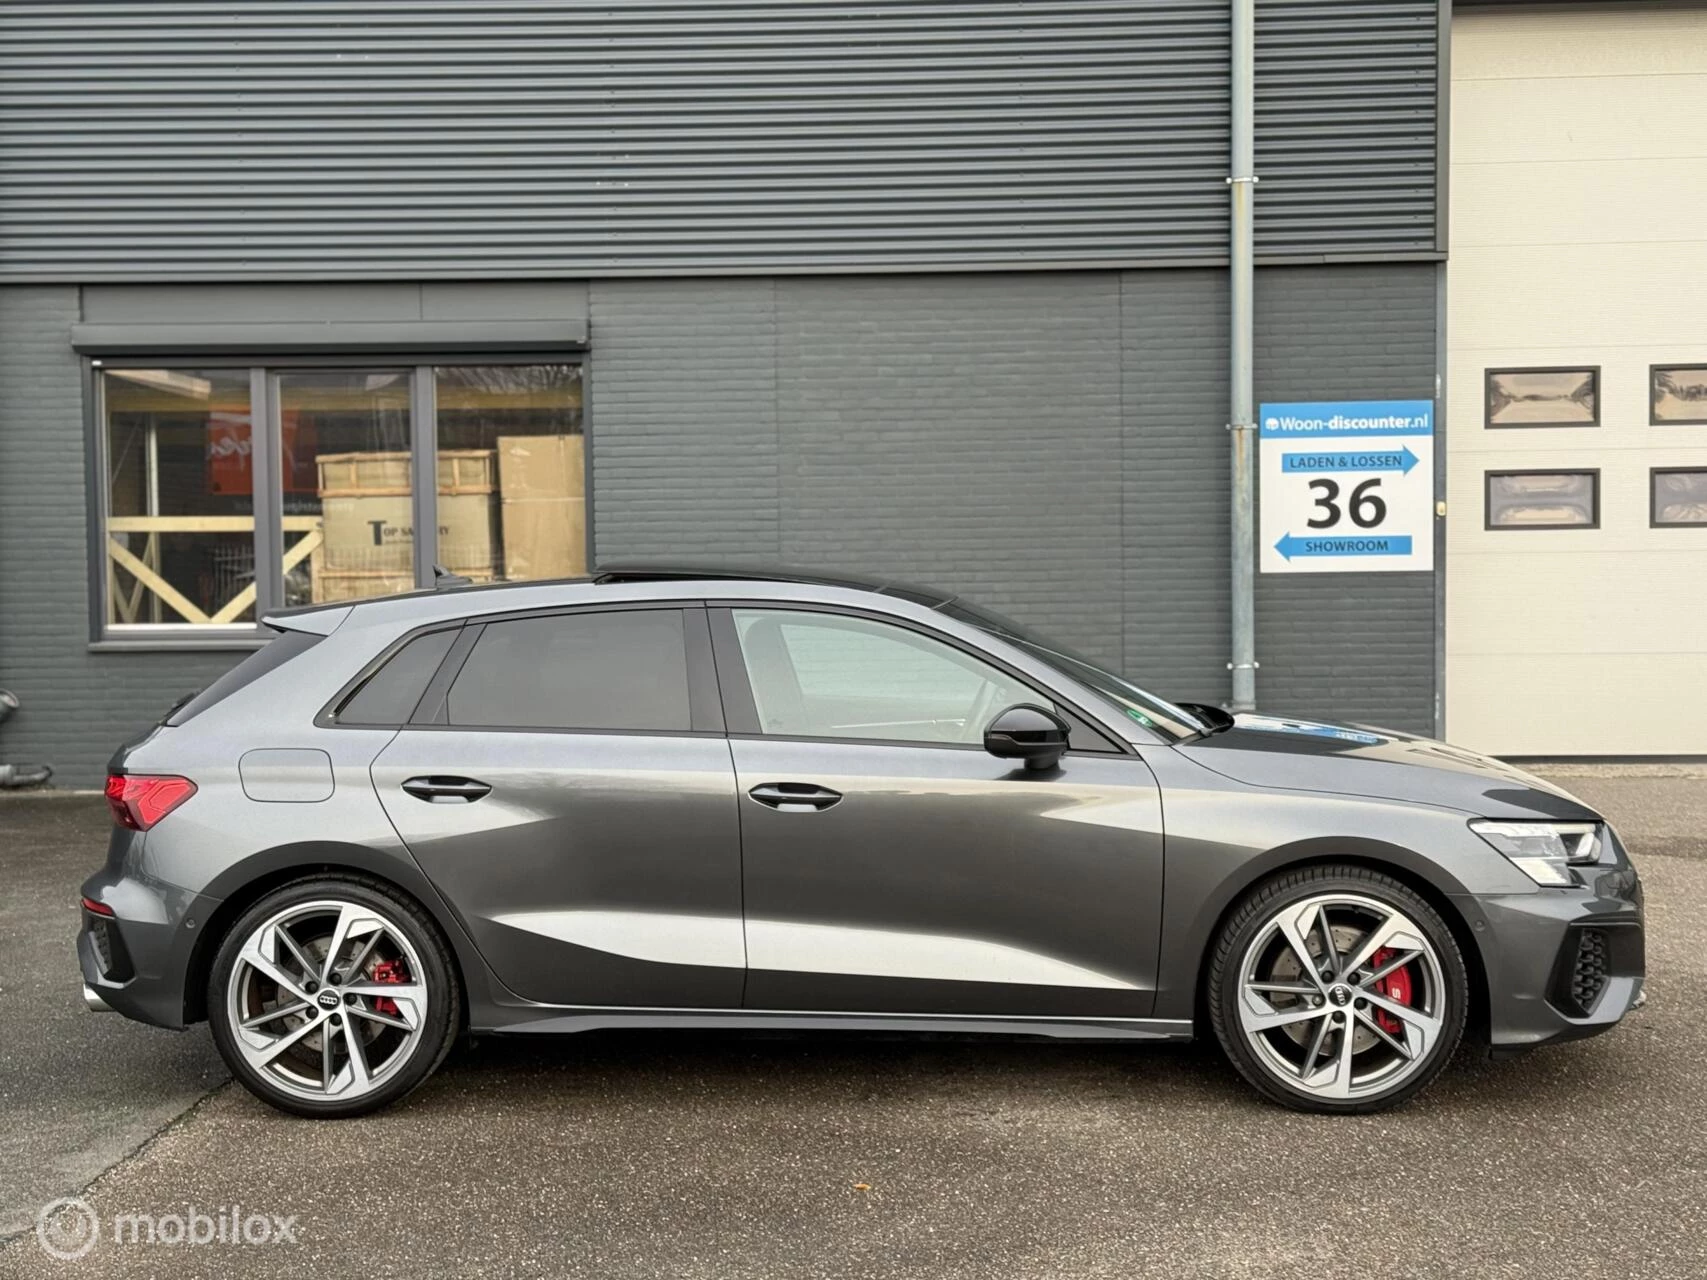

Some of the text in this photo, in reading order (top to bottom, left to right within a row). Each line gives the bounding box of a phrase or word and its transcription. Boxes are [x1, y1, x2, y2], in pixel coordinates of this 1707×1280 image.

[1279, 413, 1428, 431] Woon-discounter.nl
[1290, 455, 1402, 468] LADEN & LOSSEN
[1306, 478, 1387, 529] 36
[1305, 540, 1389, 552] SHOWROOM
